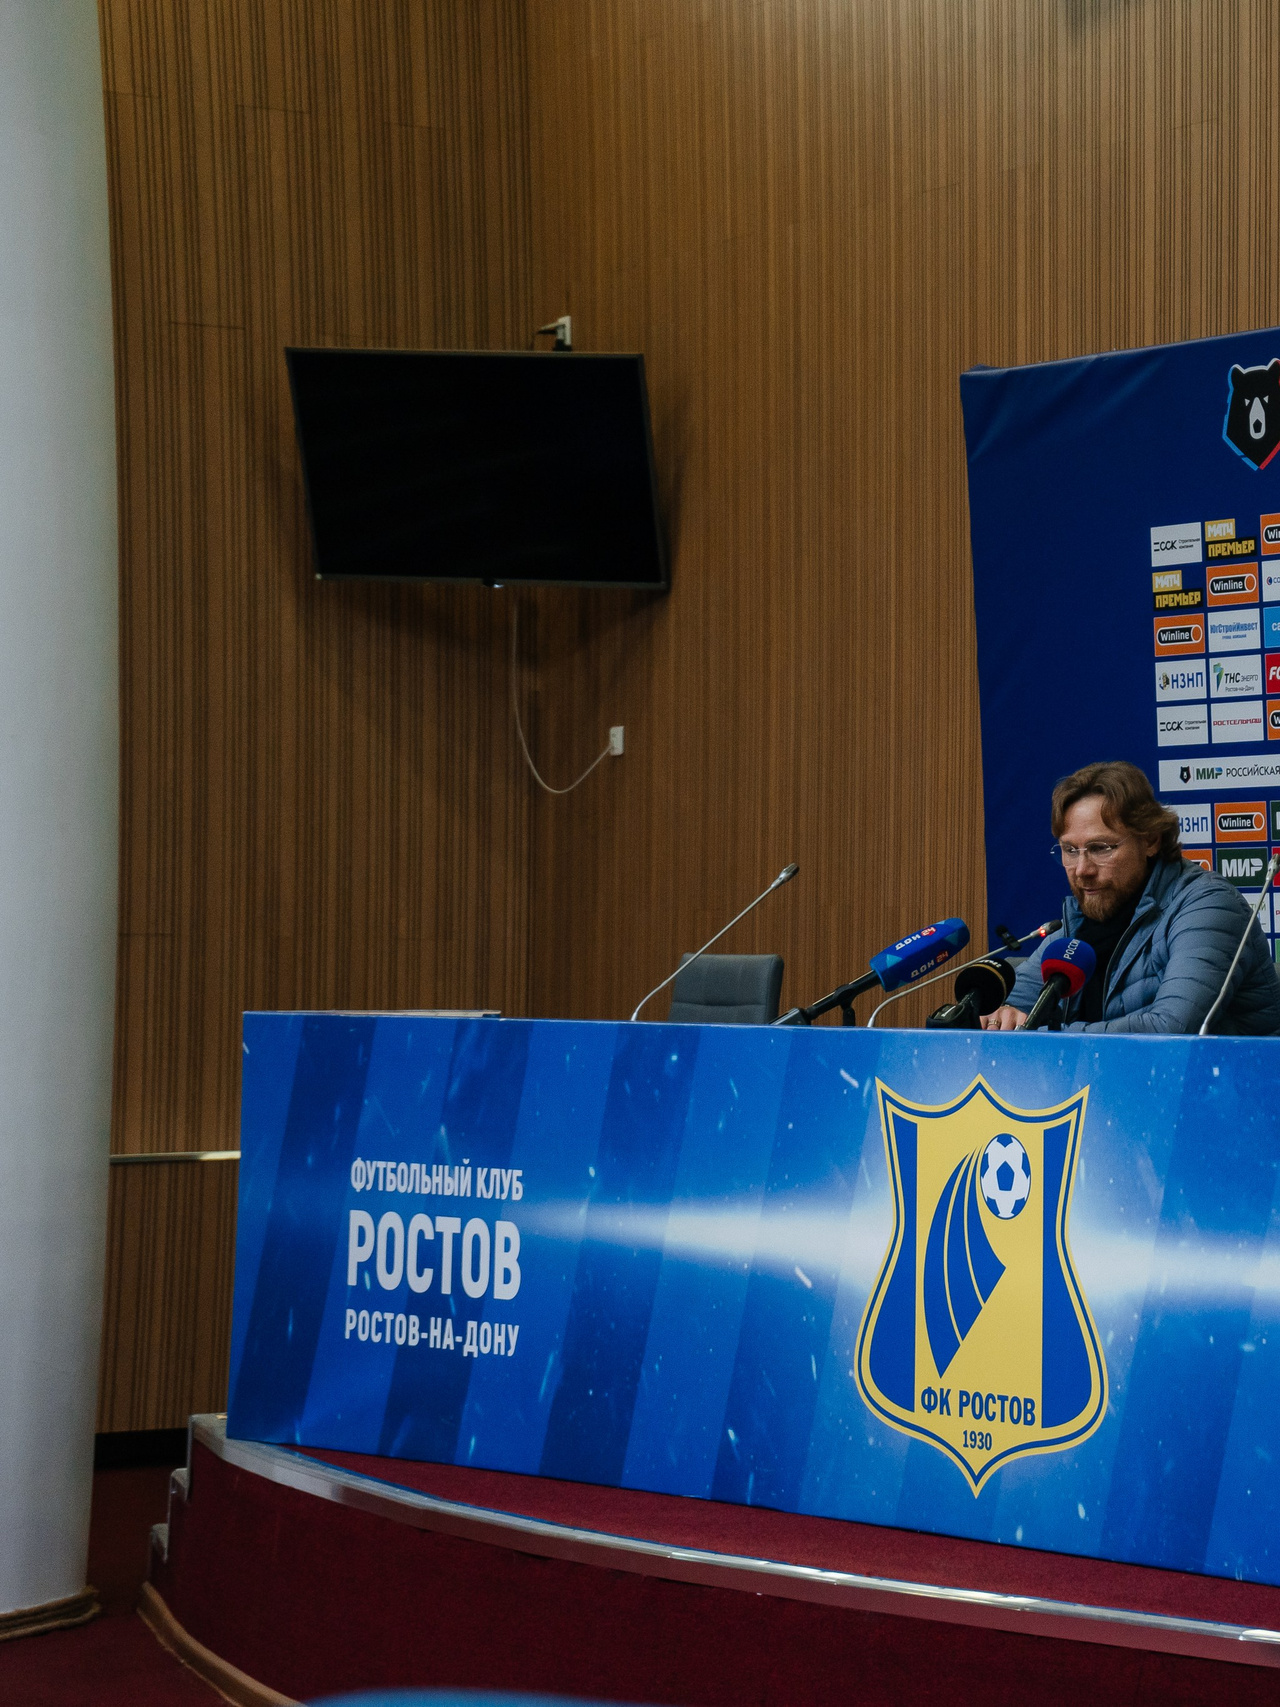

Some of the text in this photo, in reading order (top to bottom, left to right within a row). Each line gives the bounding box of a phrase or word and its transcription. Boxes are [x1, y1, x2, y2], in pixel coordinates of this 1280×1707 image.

[1208, 522, 1234, 537] МАТЧ
[1208, 540, 1255, 557] ПРЕМЬЕР
[1155, 574, 1179, 588] МАТЧ
[1156, 591, 1200, 608] ПРЕМЬЕР
[1161, 631, 1189, 642] Winline
[1210, 622, 1258, 634] ЮгСтройИнвест
[1225, 673, 1240, 683] ТНС
[1196, 767, 1223, 780] МИР
[1226, 765, 1280, 778] РОССИЙСКАЯ
[1222, 858, 1263, 877] МИР
[351, 1157, 523, 1200] ФУТБОЛЬНЫЙ КЛУБ
[347, 1210, 521, 1300] РОСТОВ
[345, 1309, 519, 1358] РОСТОВ-НА-ДОНУ
[921, 1387, 1036, 1426] ФК РОСТОВ
[963, 1430, 992, 1451] 1930
